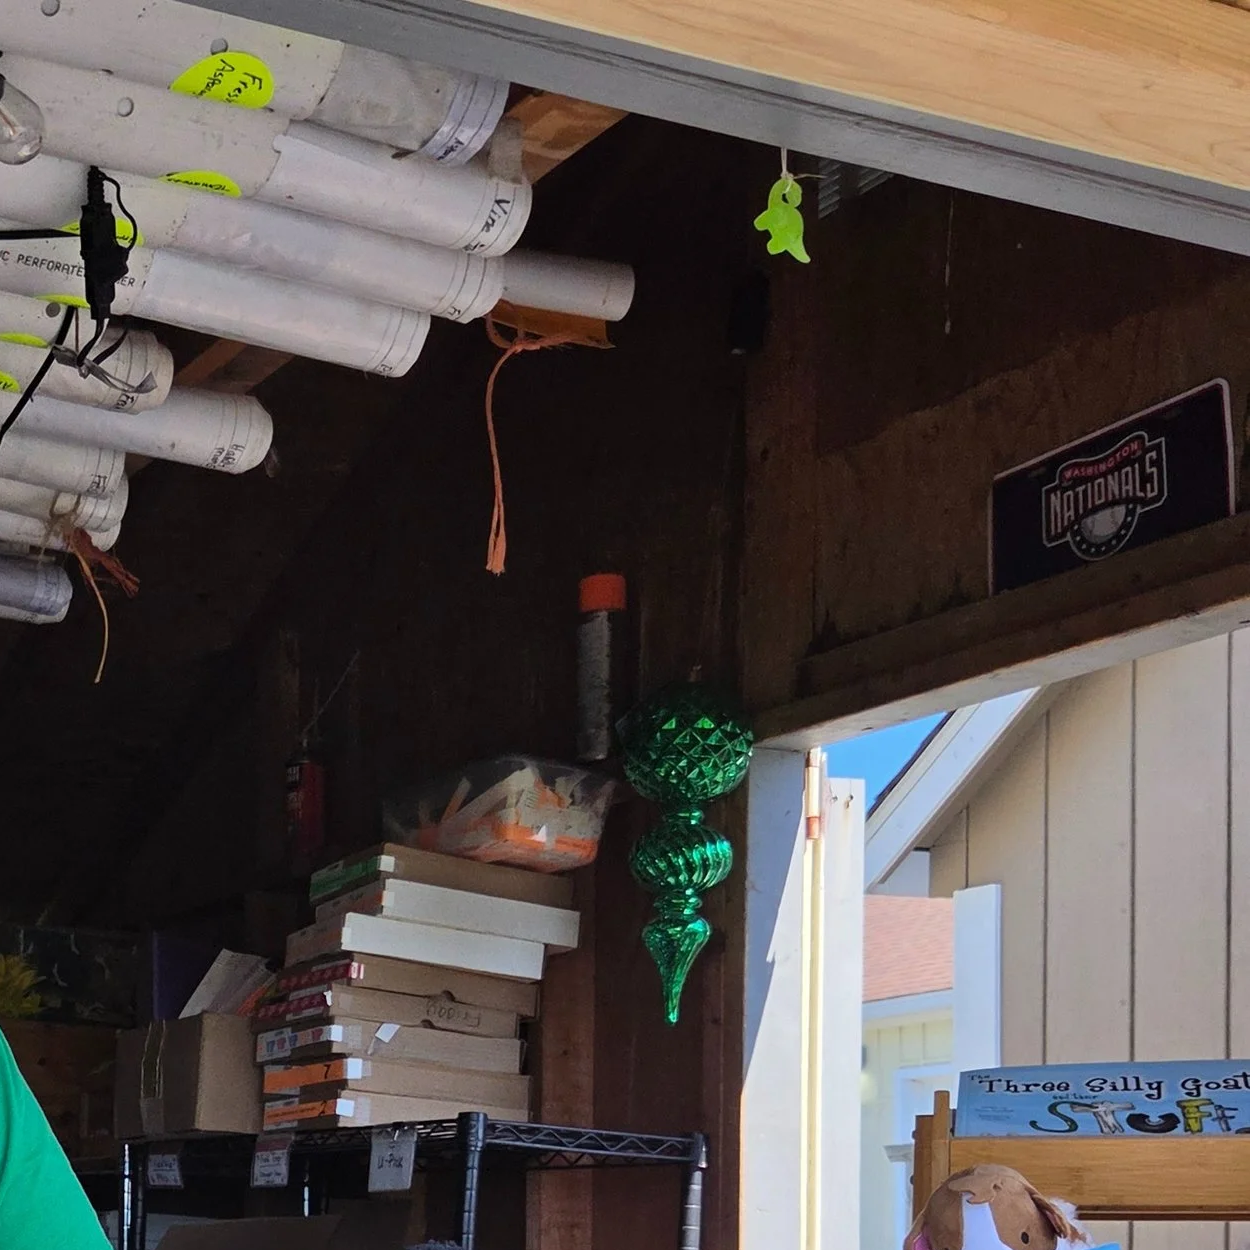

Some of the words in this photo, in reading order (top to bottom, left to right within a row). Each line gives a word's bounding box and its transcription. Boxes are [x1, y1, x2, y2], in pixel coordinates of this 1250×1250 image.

[17, 253, 87, 278] PERFORATE
[1062, 440, 1141, 479] WASHINGTON
[1050, 451, 1159, 536] NATIONALS
[978, 1078, 1071, 1093] Three
[1084, 1076, 1164, 1100] Silly
[1180, 1070, 1250, 1098] Goat
